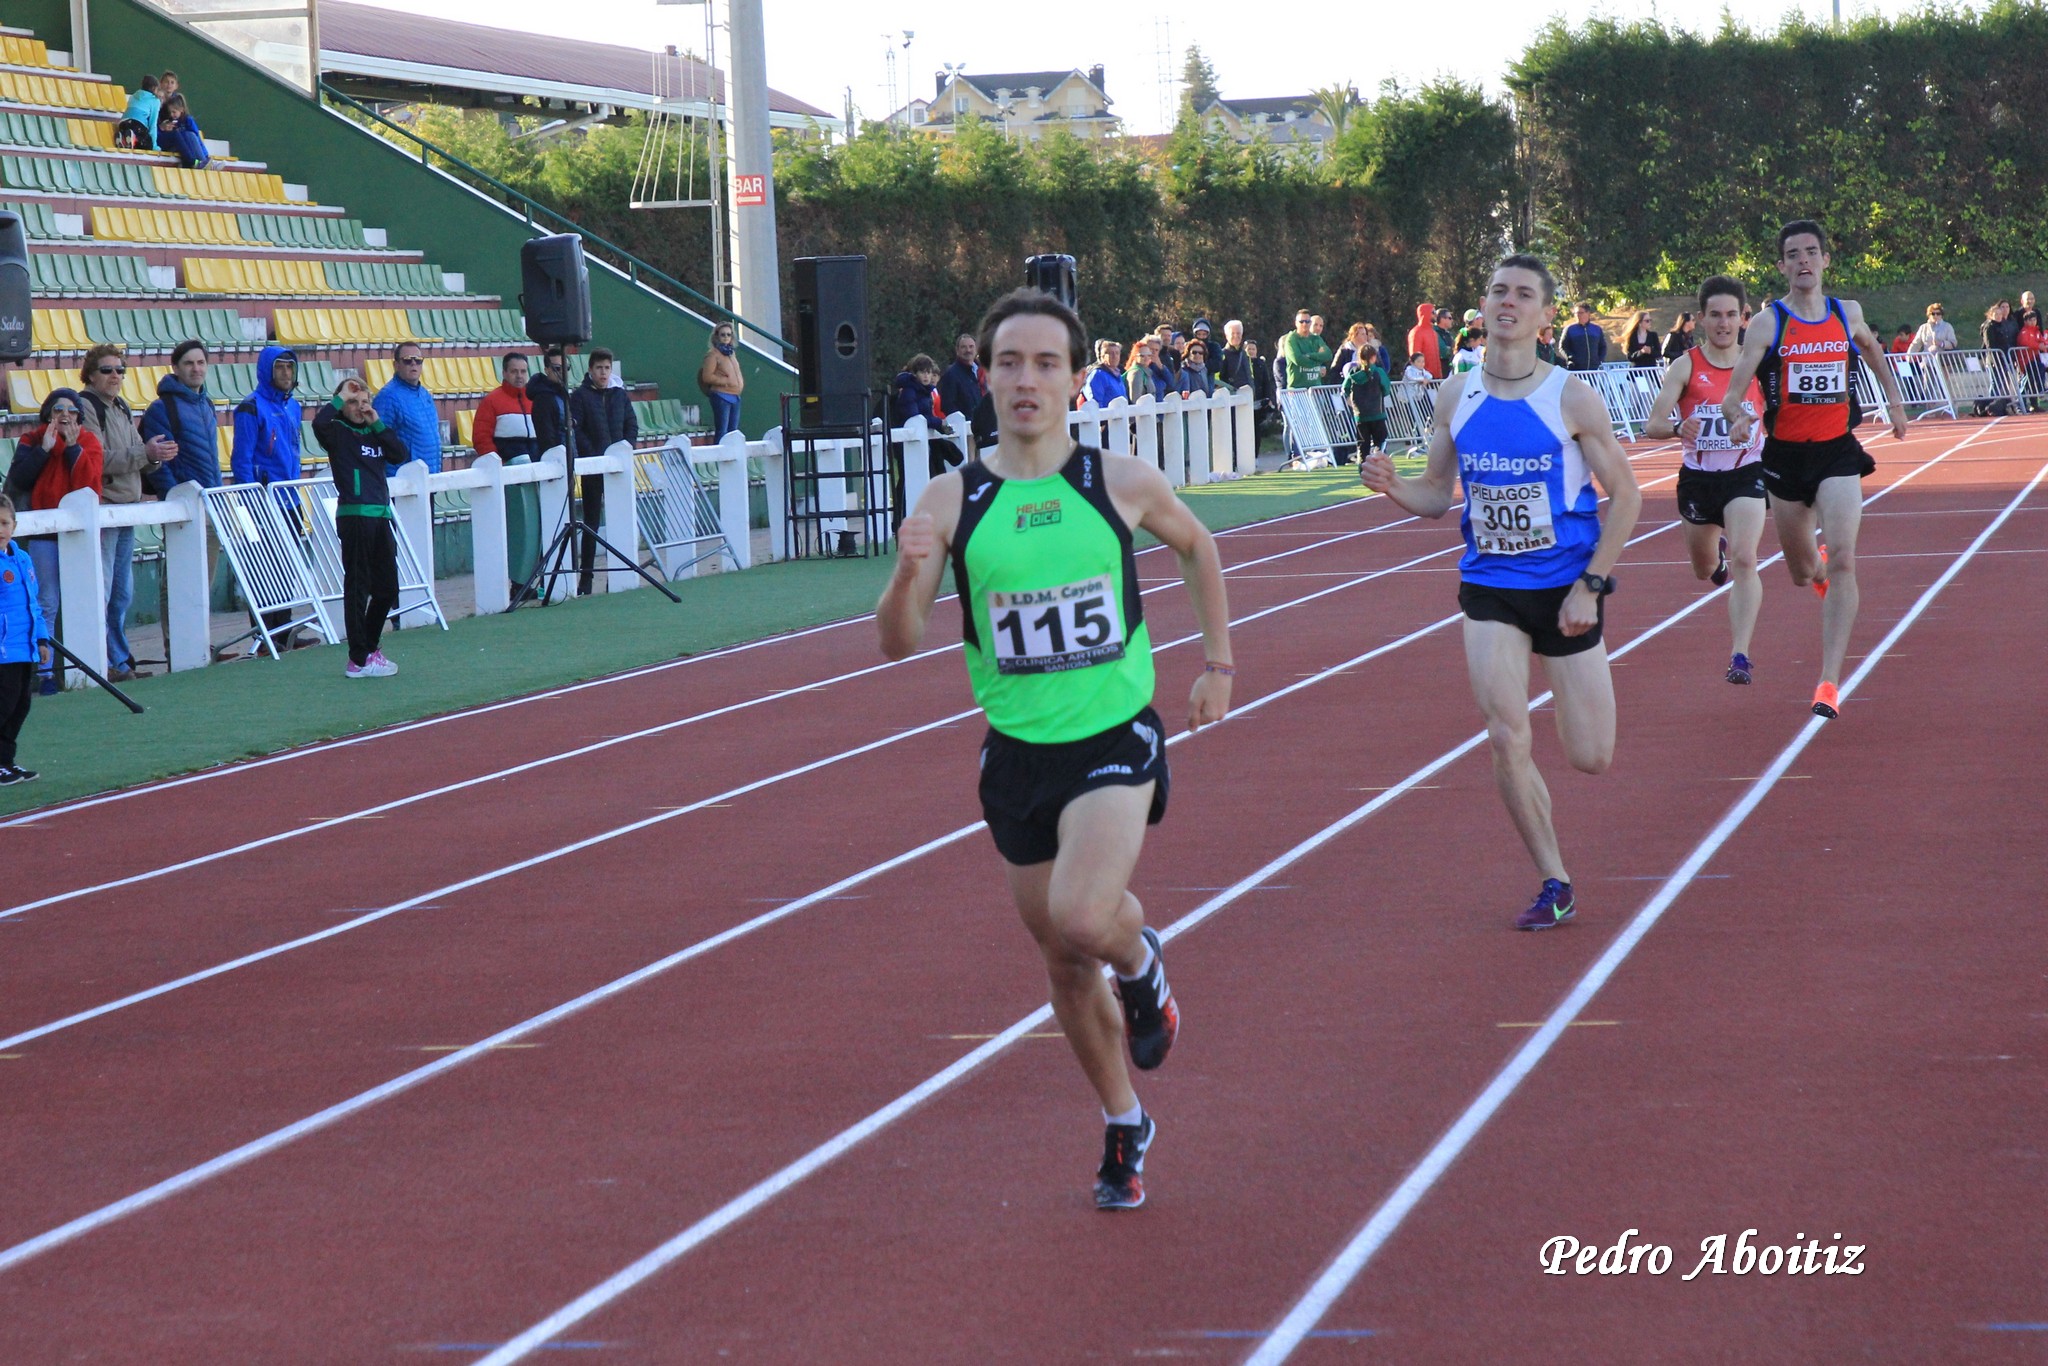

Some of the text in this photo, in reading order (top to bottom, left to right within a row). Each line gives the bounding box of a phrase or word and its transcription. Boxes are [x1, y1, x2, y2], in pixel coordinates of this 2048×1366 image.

[734, 177, 763, 193] BAR
[1777, 340, 1850, 357] CAMARGO
[1798, 374, 1839, 392] 881
[1471, 485, 1542, 501] PIELAGOS
[1483, 504, 1531, 531] 306
[1476, 535, 1551, 551] La Encina
[1061, 580, 1103, 598] Cayón
[997, 596, 1111, 656] 115
